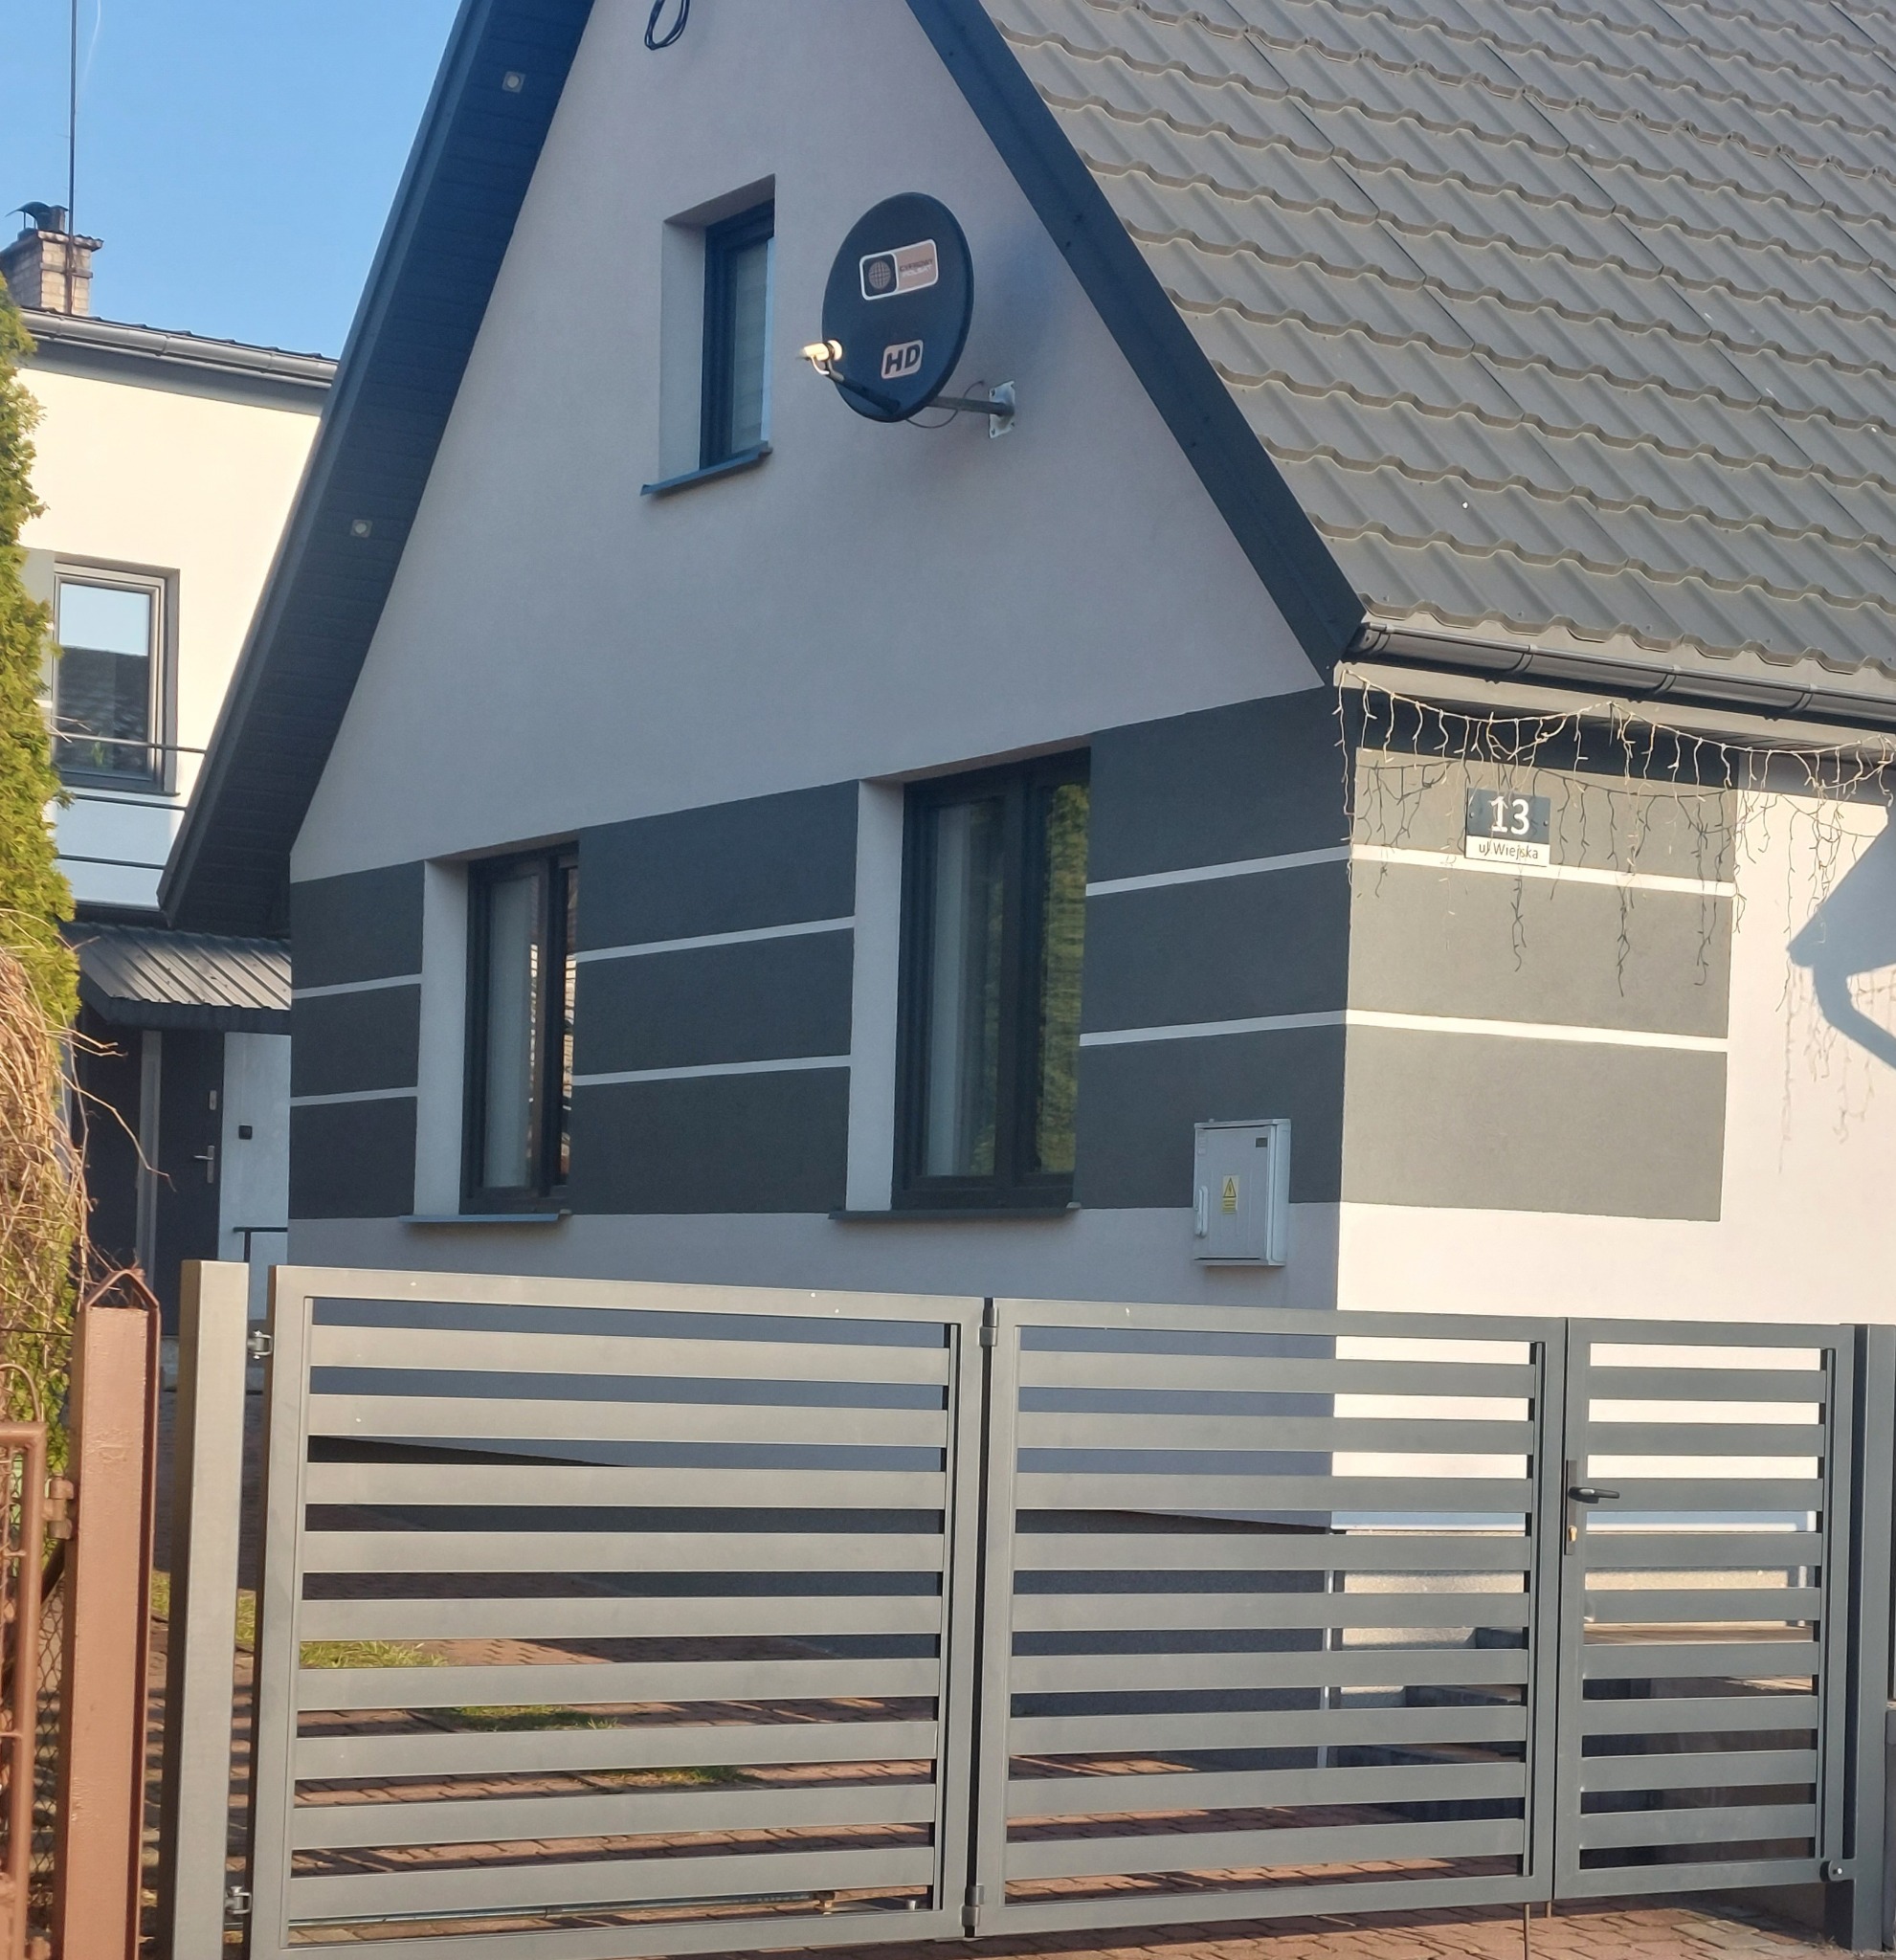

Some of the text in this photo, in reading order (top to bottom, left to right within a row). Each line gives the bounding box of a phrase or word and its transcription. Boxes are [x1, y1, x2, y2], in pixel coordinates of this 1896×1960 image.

[884, 345, 921, 374] HD
[1490, 796, 1529, 835] 13
[1493, 842, 1538, 859] Wiejska
